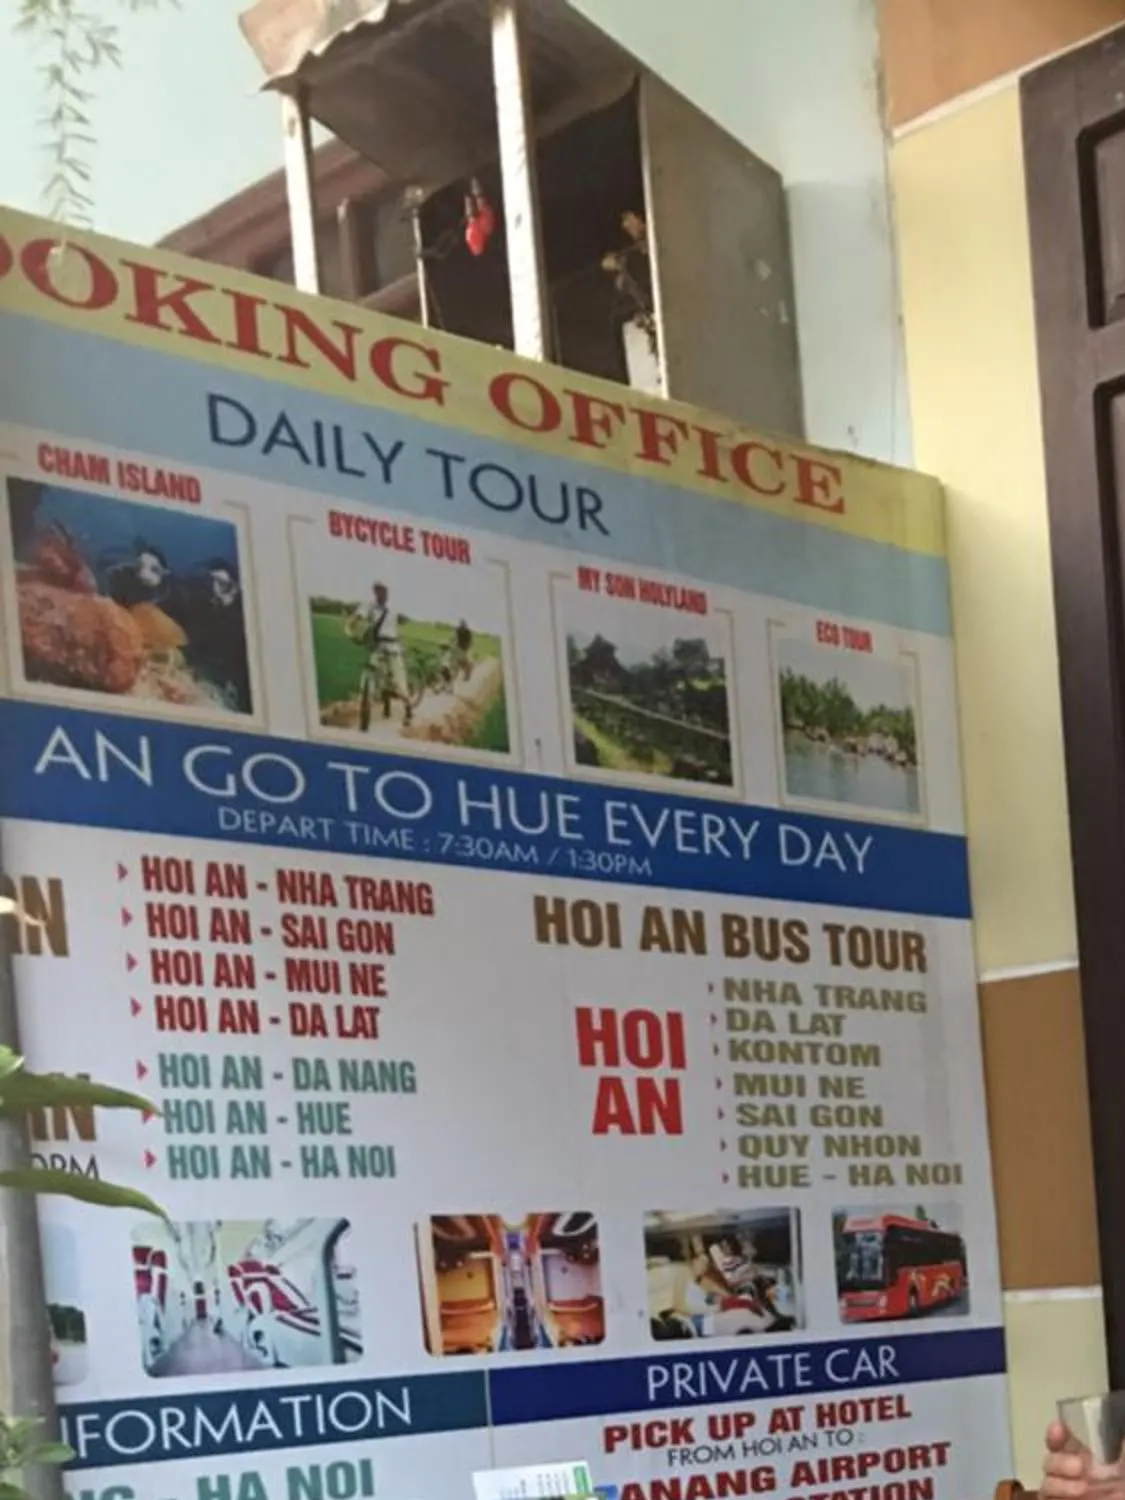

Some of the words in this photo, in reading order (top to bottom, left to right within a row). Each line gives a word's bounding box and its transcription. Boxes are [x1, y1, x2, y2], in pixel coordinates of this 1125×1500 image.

[0, 231, 450, 406] OKING
[488, 372, 845, 514] OFFICE
[38, 443, 109, 485] CHAM
[118, 461, 202, 504] ISLAND
[207, 393, 405, 484] DAILY
[427, 449, 610, 536] TOUR
[329, 510, 415, 552] BYCYCLE
[421, 530, 469, 564] TOUR
[577, 566, 600, 591] MY
[605, 573, 636, 599] SON
[816, 621, 839, 645] ECO
[843, 627, 872, 652] TOUR
[34, 726, 152, 786] AN
[183, 746, 305, 803] GO
[327, 762, 432, 819] TO
[458, 780, 584, 840] HUE
[605, 802, 760, 860] EVERY
[778, 824, 873, 874] DAY
[218, 807, 336, 842] DEPART
[344, 821, 414, 851] TIME
[437, 832, 539, 865] 7:30AM
[568, 850, 653, 876] 1:30PM
[141, 856, 194, 895] HOI
[206, 862, 248, 899] AN
[276, 869, 338, 908] NHA
[344, 875, 435, 917] TRANG
[145, 903, 198, 941] HOI
[210, 909, 252, 945] AN
[281, 915, 328, 951] SAI
[337, 919, 395, 956] GON
[534, 895, 622, 949] HOI
[639, 905, 707, 955] AN
[721, 913, 809, 964] BUS
[823, 923, 927, 973] TOUR
[150, 949, 203, 987] HOI
[214, 953, 256, 989] AN
[286, 959, 341, 995] MUI
[351, 963, 388, 998] NE
[723, 977, 804, 1006] NHA
[814, 984, 928, 1013] TRANG
[155, 996, 207, 1032] HOI
[219, 1000, 260, 1034] AN
[289, 1003, 328, 1037] DA
[337, 1006, 380, 1039] LAT
[575, 1006, 687, 1070] HOI
[726, 1009, 776, 1033] DA
[789, 1013, 846, 1037] LAT
[158, 1053, 211, 1089] HOI
[222, 1056, 263, 1090] AN
[293, 1057, 332, 1092] DA
[340, 1059, 417, 1094] NANG
[728, 1040, 880, 1067] KONTOM
[592, 1076, 683, 1136] AN
[733, 1073, 806, 1098] MUI
[819, 1076, 865, 1099] NE
[163, 1099, 215, 1135] HOI
[226, 1102, 268, 1135] AN
[298, 1102, 352, 1135] HUE
[736, 1103, 797, 1127] SAI
[810, 1104, 883, 1128] GON
[168, 1145, 220, 1180] HOI
[230, 1145, 271, 1179] AN
[301, 1145, 340, 1178] HA
[347, 1145, 396, 1178] NOI
[738, 1135, 810, 1160] QUY
[824, 1135, 921, 1157] NHON
[738, 1165, 811, 1188] HUE
[849, 1164, 896, 1187] HA
[906, 1162, 962, 1185] NOI
[647, 1352, 812, 1400] PRIVATE
[825, 1345, 899, 1382] CAR
[61, 1387, 412, 1459] FORMATION
[604, 1419, 695, 1453] PICK
[708, 1412, 756, 1441] UP
[768, 1406, 806, 1434] AT
[816, 1394, 912, 1430] HOTEL
[668, 1445, 736, 1467] FROM
[742, 1439, 782, 1459] HOI
[787, 1434, 819, 1452] AN
[825, 1429, 854, 1448] TO
[791, 1442, 951, 1488] AIRPORT
